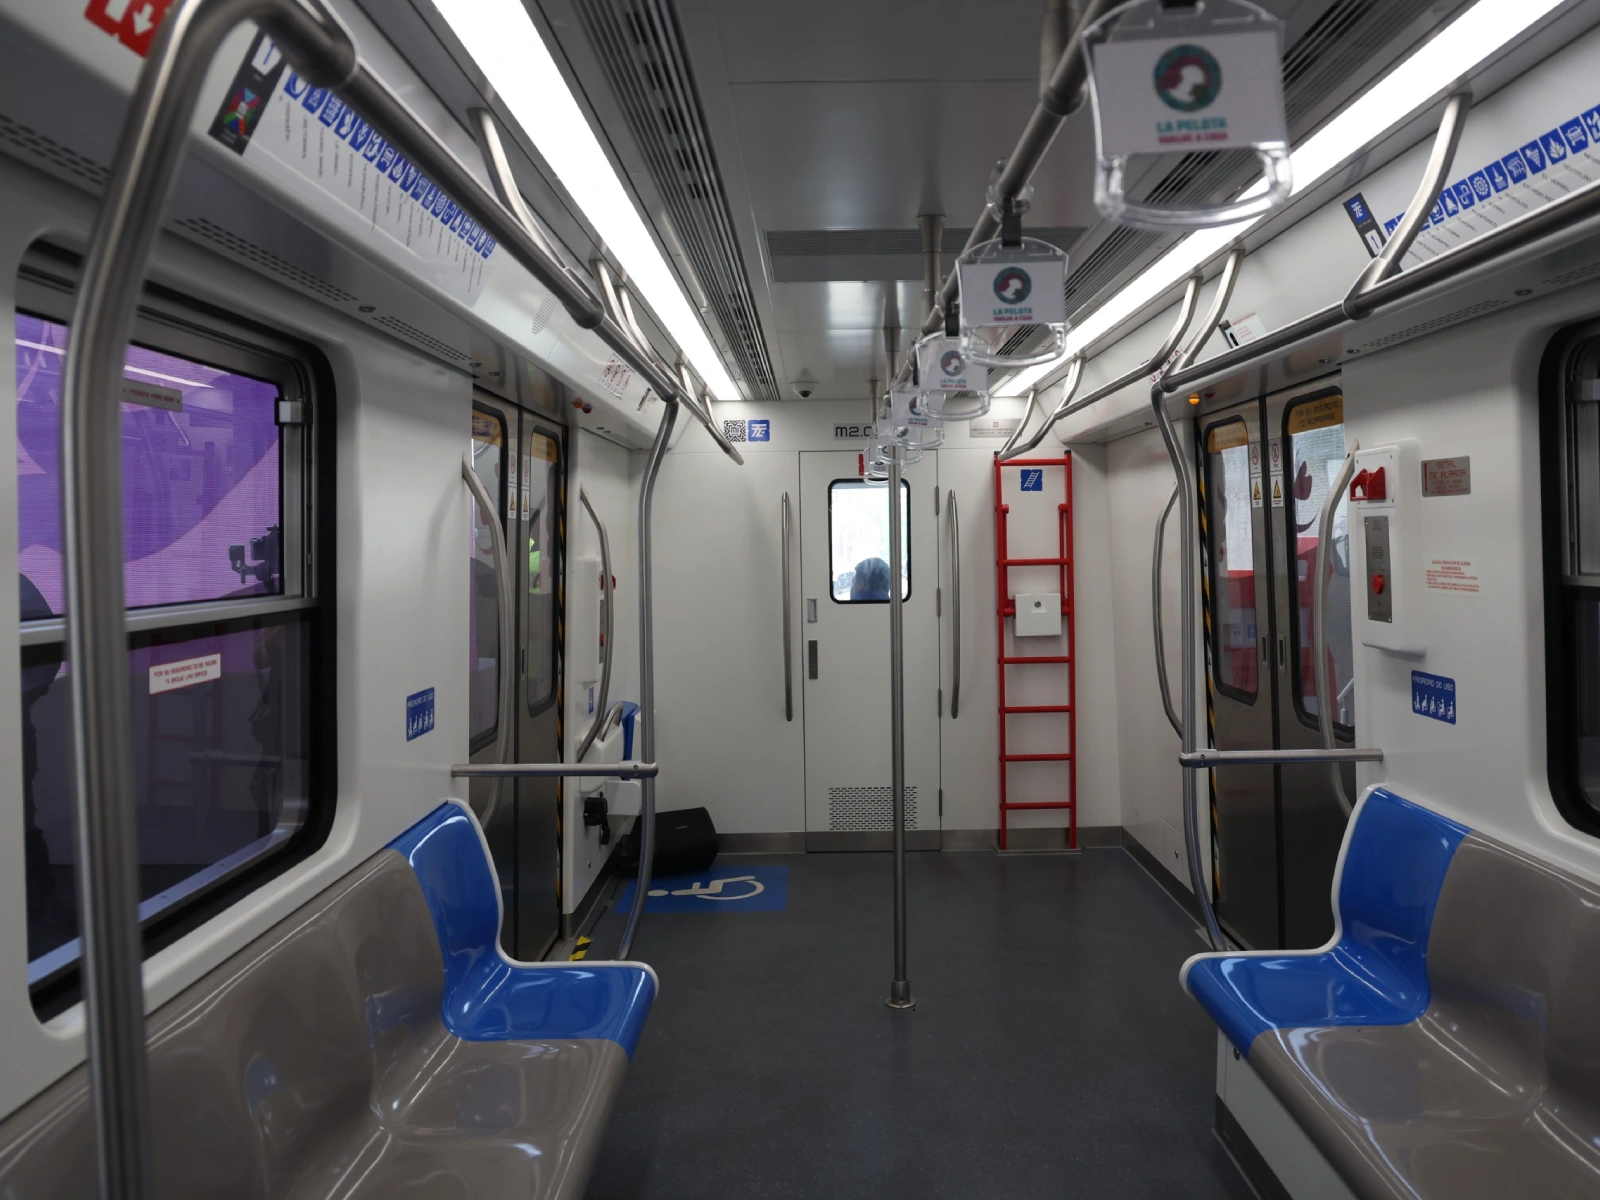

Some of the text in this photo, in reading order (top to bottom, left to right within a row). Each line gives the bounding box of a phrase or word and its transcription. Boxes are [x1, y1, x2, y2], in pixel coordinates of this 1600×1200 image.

[1436, 459, 1457, 469] SEÑAL
[1429, 468, 1467, 479] DE ALARMA
[1412, 675, 1434, 687] PRIORIDAD
[1444, 683, 1454, 691] USO
